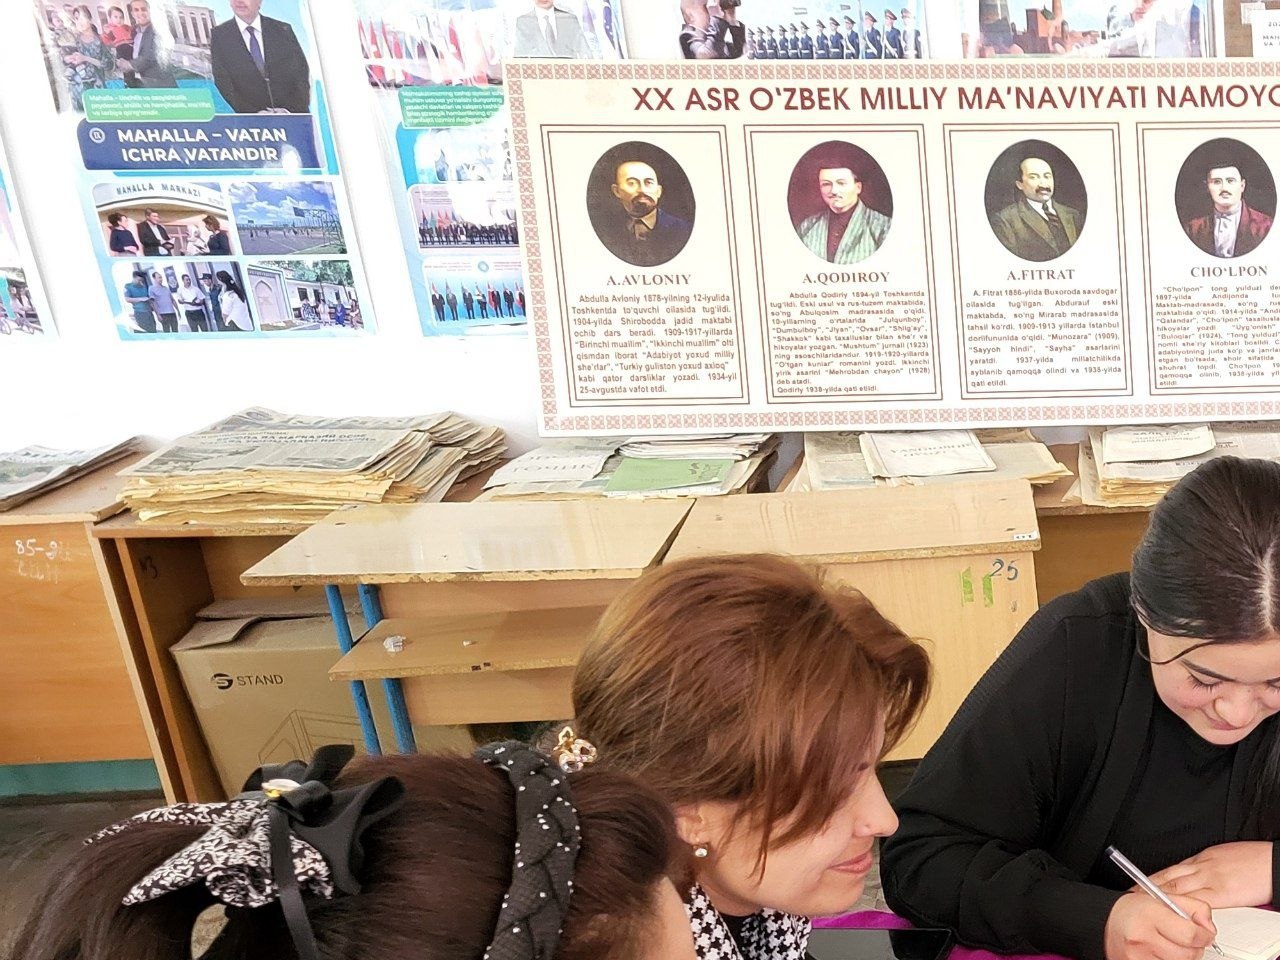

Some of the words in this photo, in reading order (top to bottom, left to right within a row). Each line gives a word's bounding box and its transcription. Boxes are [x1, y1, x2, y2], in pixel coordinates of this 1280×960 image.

[632, 87, 674, 111] XX
[685, 87, 740, 111] ASR
[749, 86, 851, 111] O‘ZBEK
[861, 86, 947, 110] MILLIY
[957, 85, 1147, 110] MA’NAVIYATI
[117, 129, 209, 142] MAHALLA
[225, 128, 287, 142] VATAN
[122, 148, 181, 162] ICHRA
[183, 147, 279, 162] VATANDIR
[116, 183, 154, 195] MAHALLA
[162, 184, 200, 198] MARKAZI
[1007, 269, 1075, 281] A.FITRAT
[1190, 265, 1268, 278] CHO‘LPON
[606, 274, 692, 286] A.AVLONIY
[802, 271, 889, 286] A.QODIROY
[578, 294, 609, 303] Abdulla
[611, 294, 641, 304] Avloniy
[643, 294, 690, 304] 1878-yilning
[692, 293, 730, 303] 12-iyulida
[570, 306, 617, 315] Toshkentda
[665, 305, 696, 314] oilasida
[573, 317, 613, 327] 1904-yilda
[673, 316, 693, 326] jadid
[701, 316, 732, 324] maktabi
[573, 329, 596, 337] ochib
[603, 329, 622, 337] dars
[628, 328, 656, 337] beradi.
[663, 327, 733, 337] 1909-1917-yillarda
[574, 340, 610, 349] “Birinchi
[649, 339, 684, 347] “Ikkinchi
[685, 338, 720, 347] muallim”
[721, 338, 734, 347] olti
[575, 352, 610, 361] qismdan
[614, 351, 638, 360] iborat
[641, 351, 682, 360] “Adabiyot
[685, 350, 710, 360] yoxud
[713, 349, 735, 359] milliy
[614, 362, 643, 372] “Turkiy
[644, 362, 677, 372] guliston
[677, 361, 702, 371] yoxud
[578, 374, 595, 382] kabi
[602, 374, 623, 384] qator
[629, 373, 666, 382] darsliklar
[672, 373, 700, 383] yozadi.
[707, 372, 737, 382] 1934-yil
[579, 385, 627, 395] 25-avgustda
[628, 384, 649, 393] vafot
[650, 384, 667, 393] etdi.
[991, 558, 1020, 581] 25
[237, 674, 284, 686] STAND
